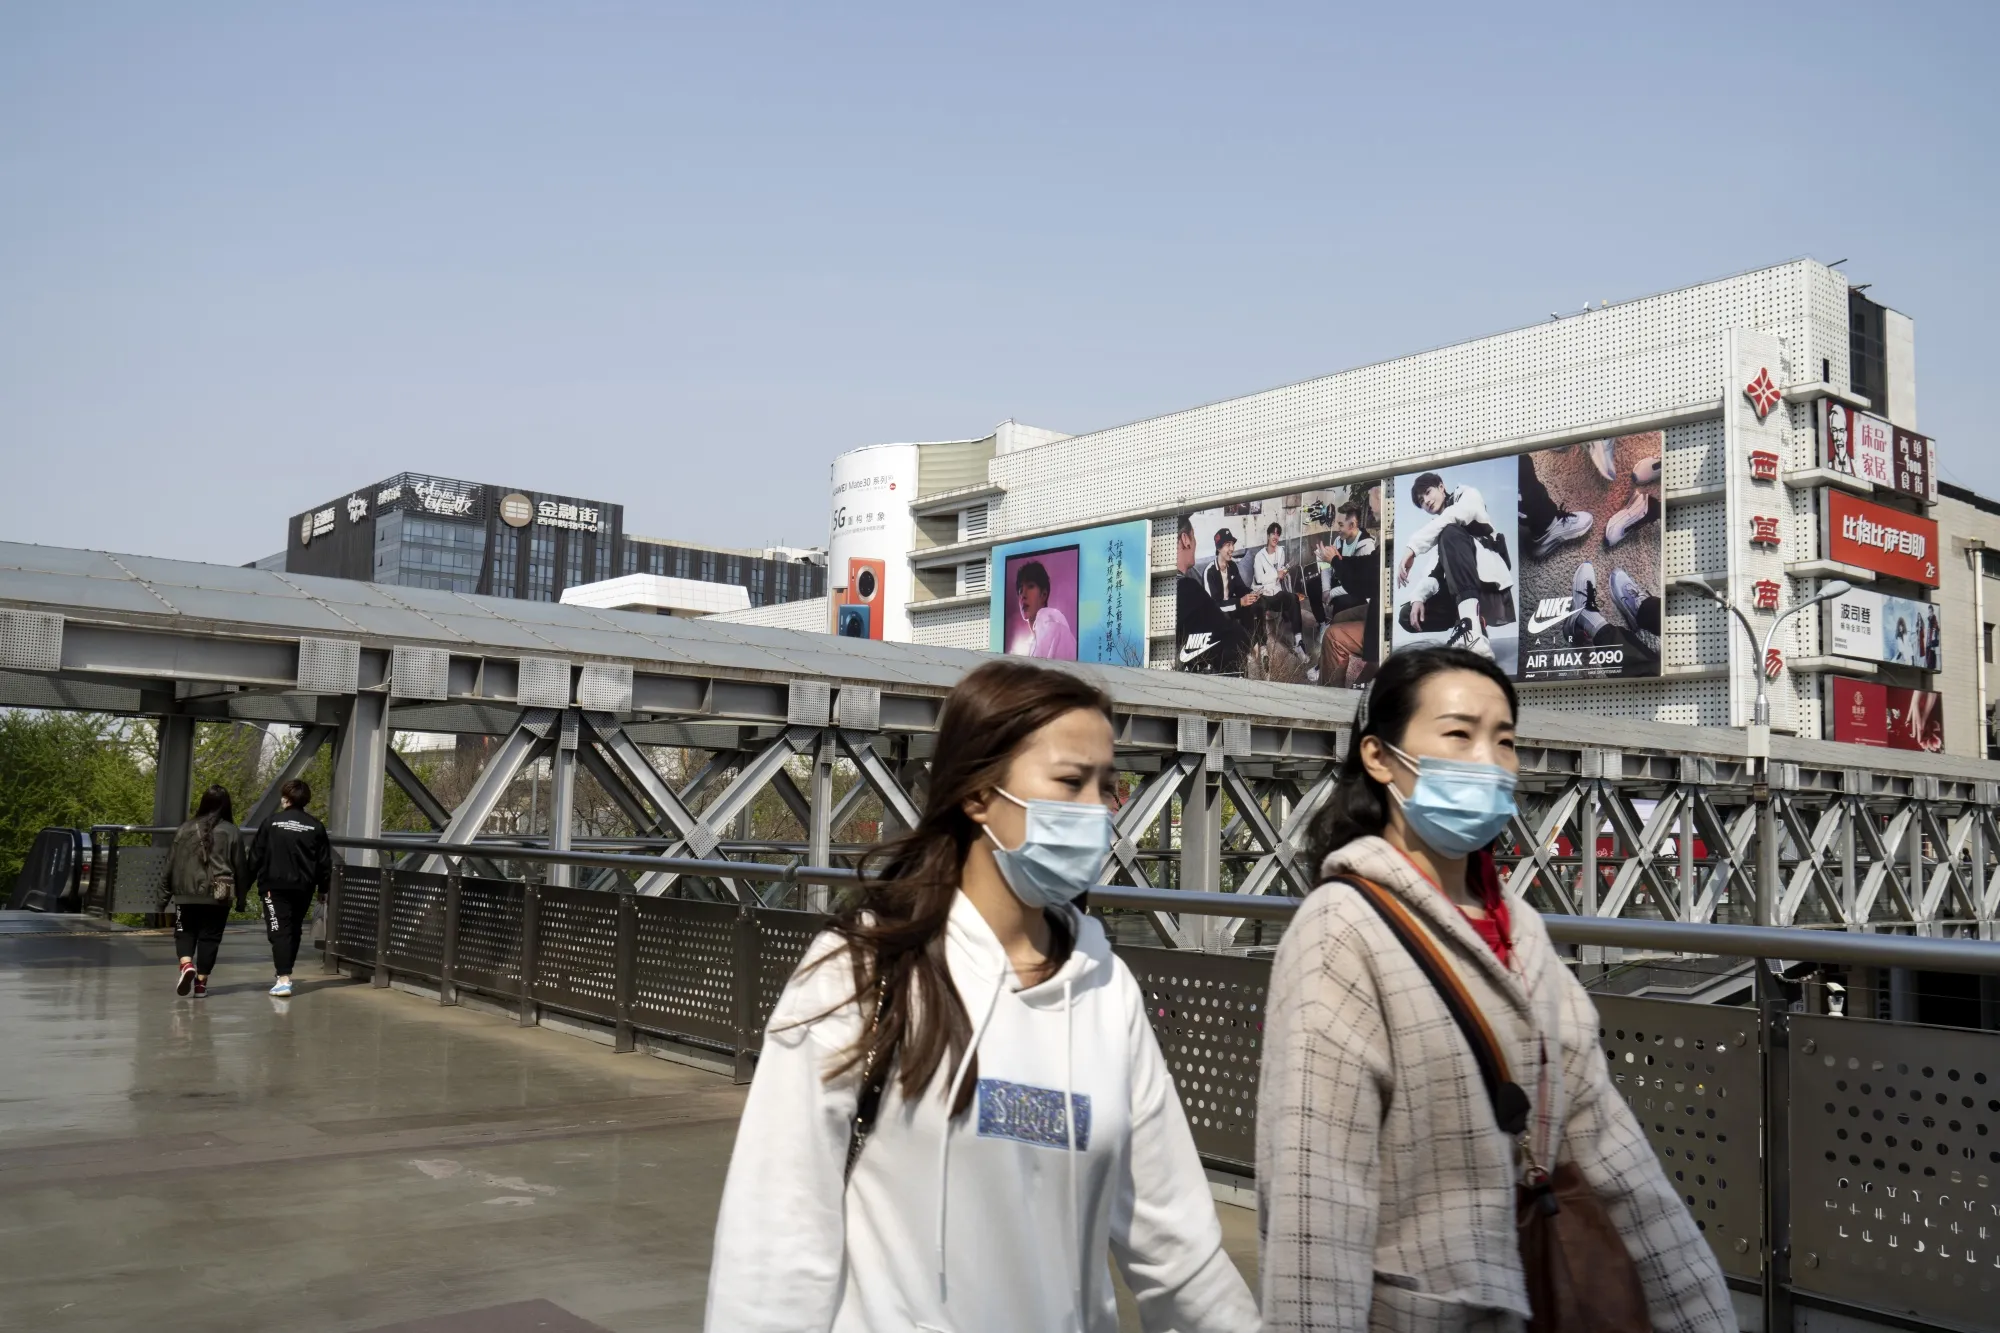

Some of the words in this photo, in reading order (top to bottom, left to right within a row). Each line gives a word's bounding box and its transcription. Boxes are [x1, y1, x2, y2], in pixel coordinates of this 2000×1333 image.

[1862, 453, 1887, 480] 家居
[538, 501, 598, 523] 金融街
[833, 506, 846, 531] 5G
[537, 517, 598, 532] 西单购物中心
[1842, 514, 1925, 560] 比格比萨自助
[1925, 562, 1935, 578] 2F
[1535, 597, 1573, 618] NIKE
[1841, 603, 1871, 624] 波司登
[1185, 632, 1212, 649] NIKE
[1526, 655, 1547, 668] AIR
[1553, 653, 1582, 667] MAX
[1589, 650, 1623, 665] 2090
